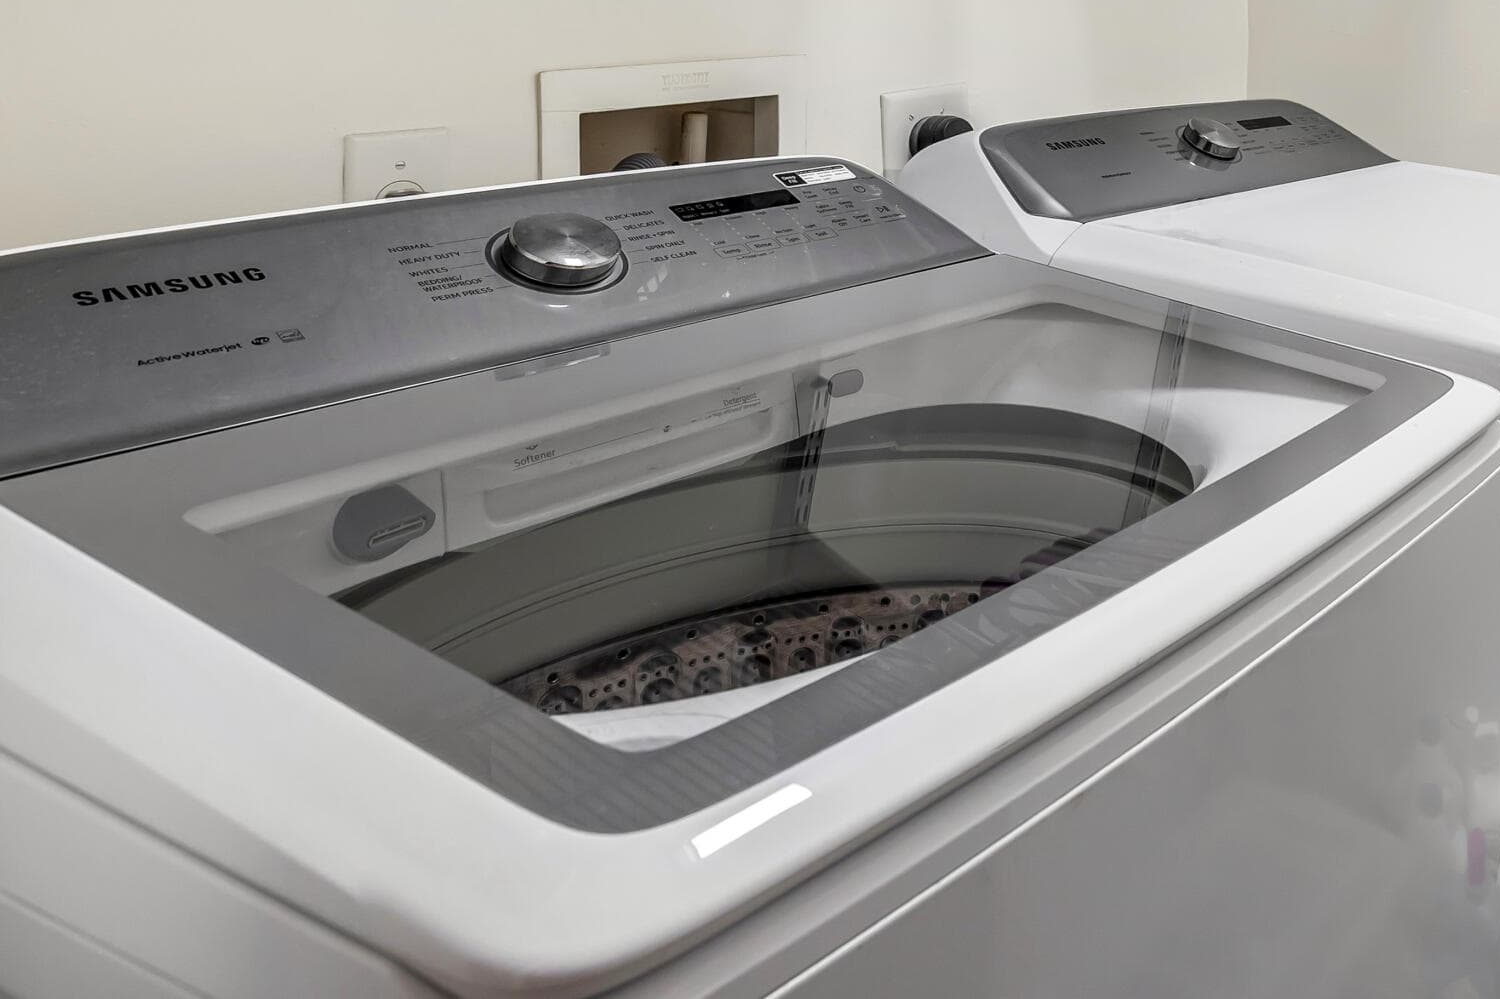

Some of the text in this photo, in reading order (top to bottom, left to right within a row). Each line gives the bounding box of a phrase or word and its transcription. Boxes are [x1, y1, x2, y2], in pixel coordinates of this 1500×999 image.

[1046, 137, 1106, 151] SAMSUNG
[604, 209, 655, 222] QUICK WASH
[622, 220, 665, 231] DELICATES
[627, 233, 652, 242] RINSE
[656, 229, 676, 237] SPIN
[387, 243, 433, 254] NORMAL
[664, 239, 686, 248] ONLY
[398, 251, 460, 266] HEAVY DUTY
[650, 250, 697, 263] SELF CLEAN
[408, 266, 449, 278] WHITES
[72, 267, 266, 307] SAMSUNG
[417, 274, 462, 287] BEDDING/
[422, 278, 483, 293] WATERPROOF
[431, 286, 494, 303] PERM PRESS
[137, 342, 243, 367] ActiveWaterjet
[722, 391, 757, 407] Detergent
[513, 449, 556, 469] Softener
